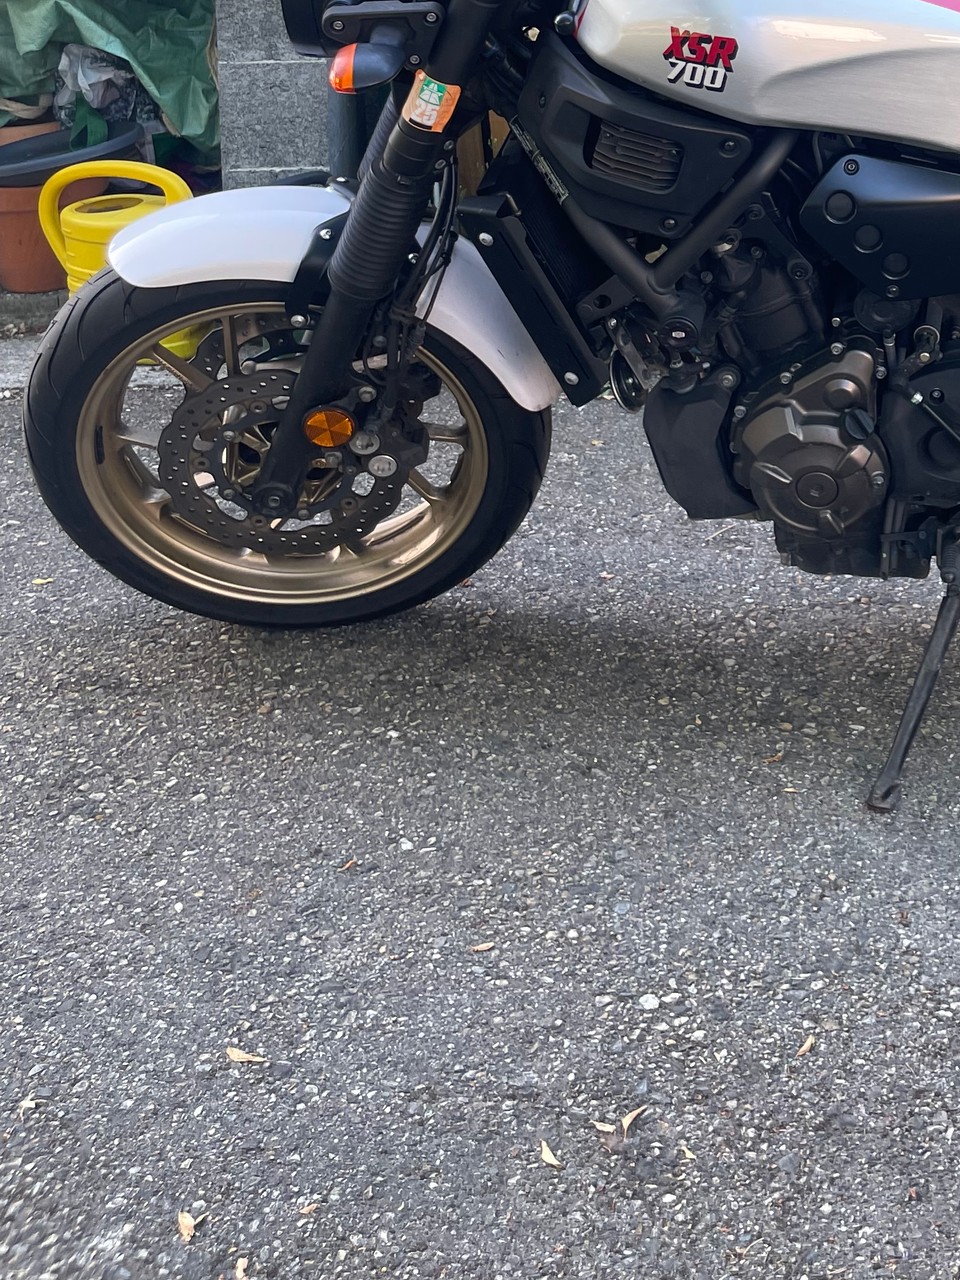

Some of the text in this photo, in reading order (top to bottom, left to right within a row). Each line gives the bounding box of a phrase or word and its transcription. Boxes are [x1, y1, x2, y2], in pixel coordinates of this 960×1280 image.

[663, 26, 738, 72] XSR
[667, 59, 727, 92] 700
[410, 98, 440, 126] 25
